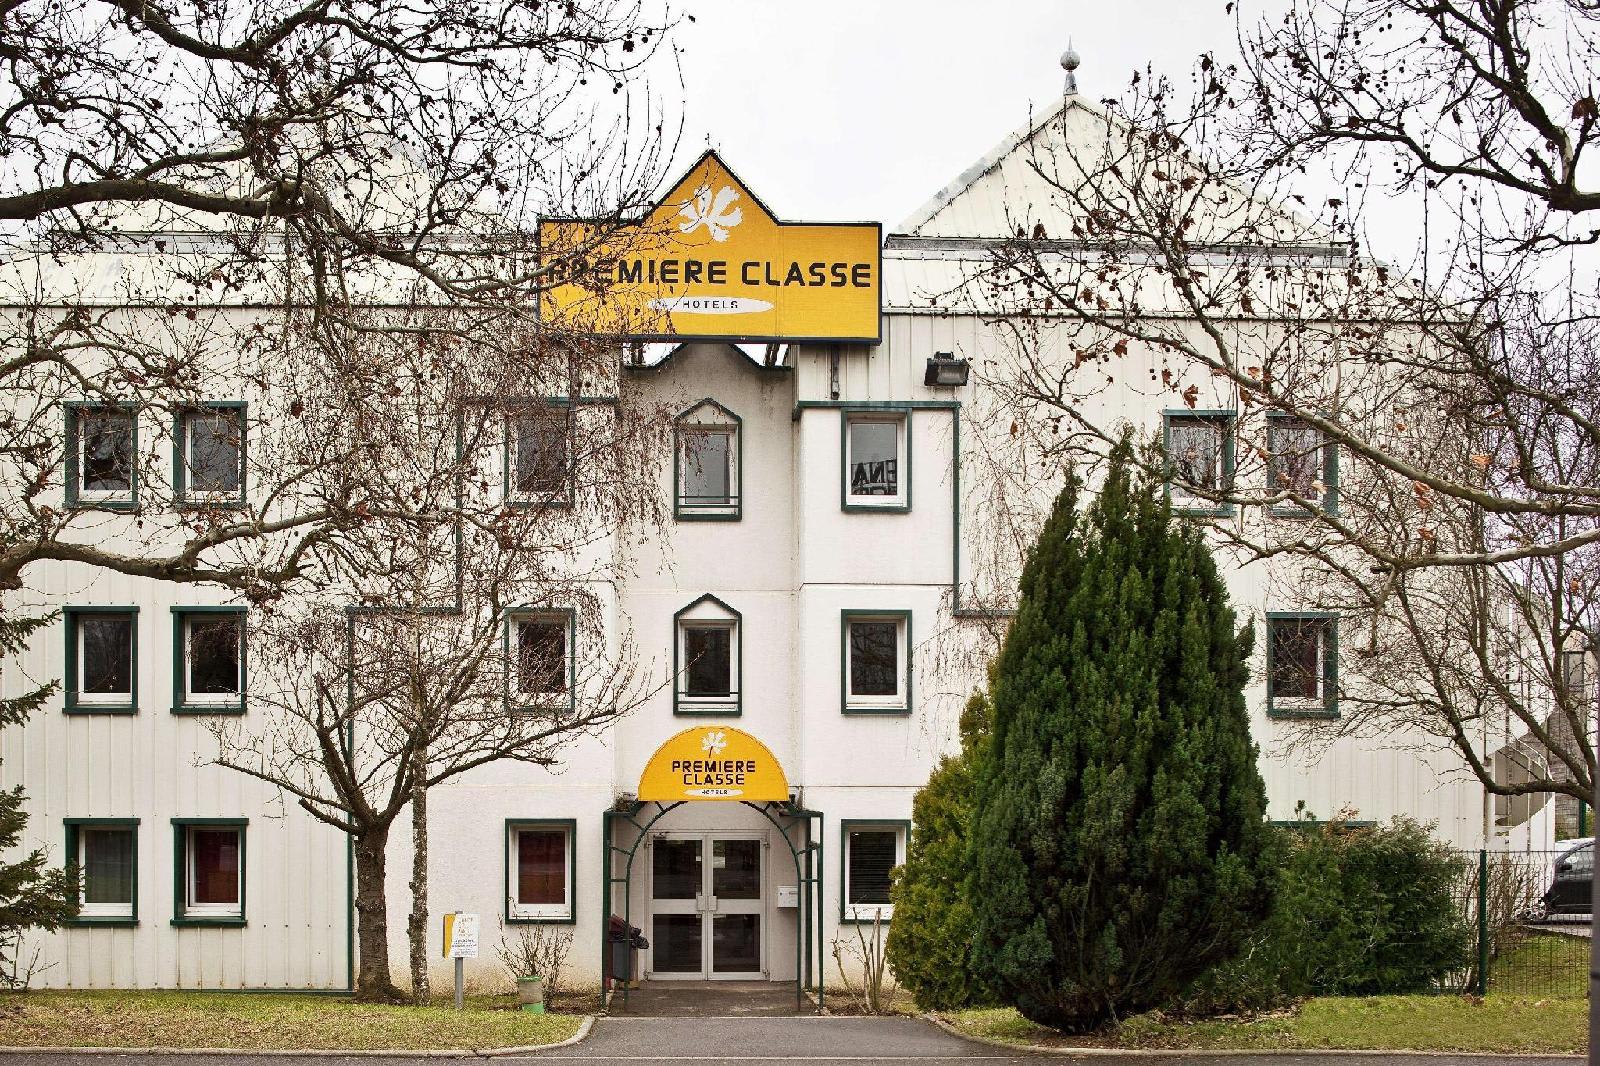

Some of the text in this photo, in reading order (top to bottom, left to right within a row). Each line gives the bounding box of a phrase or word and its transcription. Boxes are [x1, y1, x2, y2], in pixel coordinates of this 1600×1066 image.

[741, 261, 871, 287] CLASSE
[683, 300, 738, 309] HOTELS
[672, 760, 756, 773] PREMIERE
[683, 773, 745, 785] CLASSE
